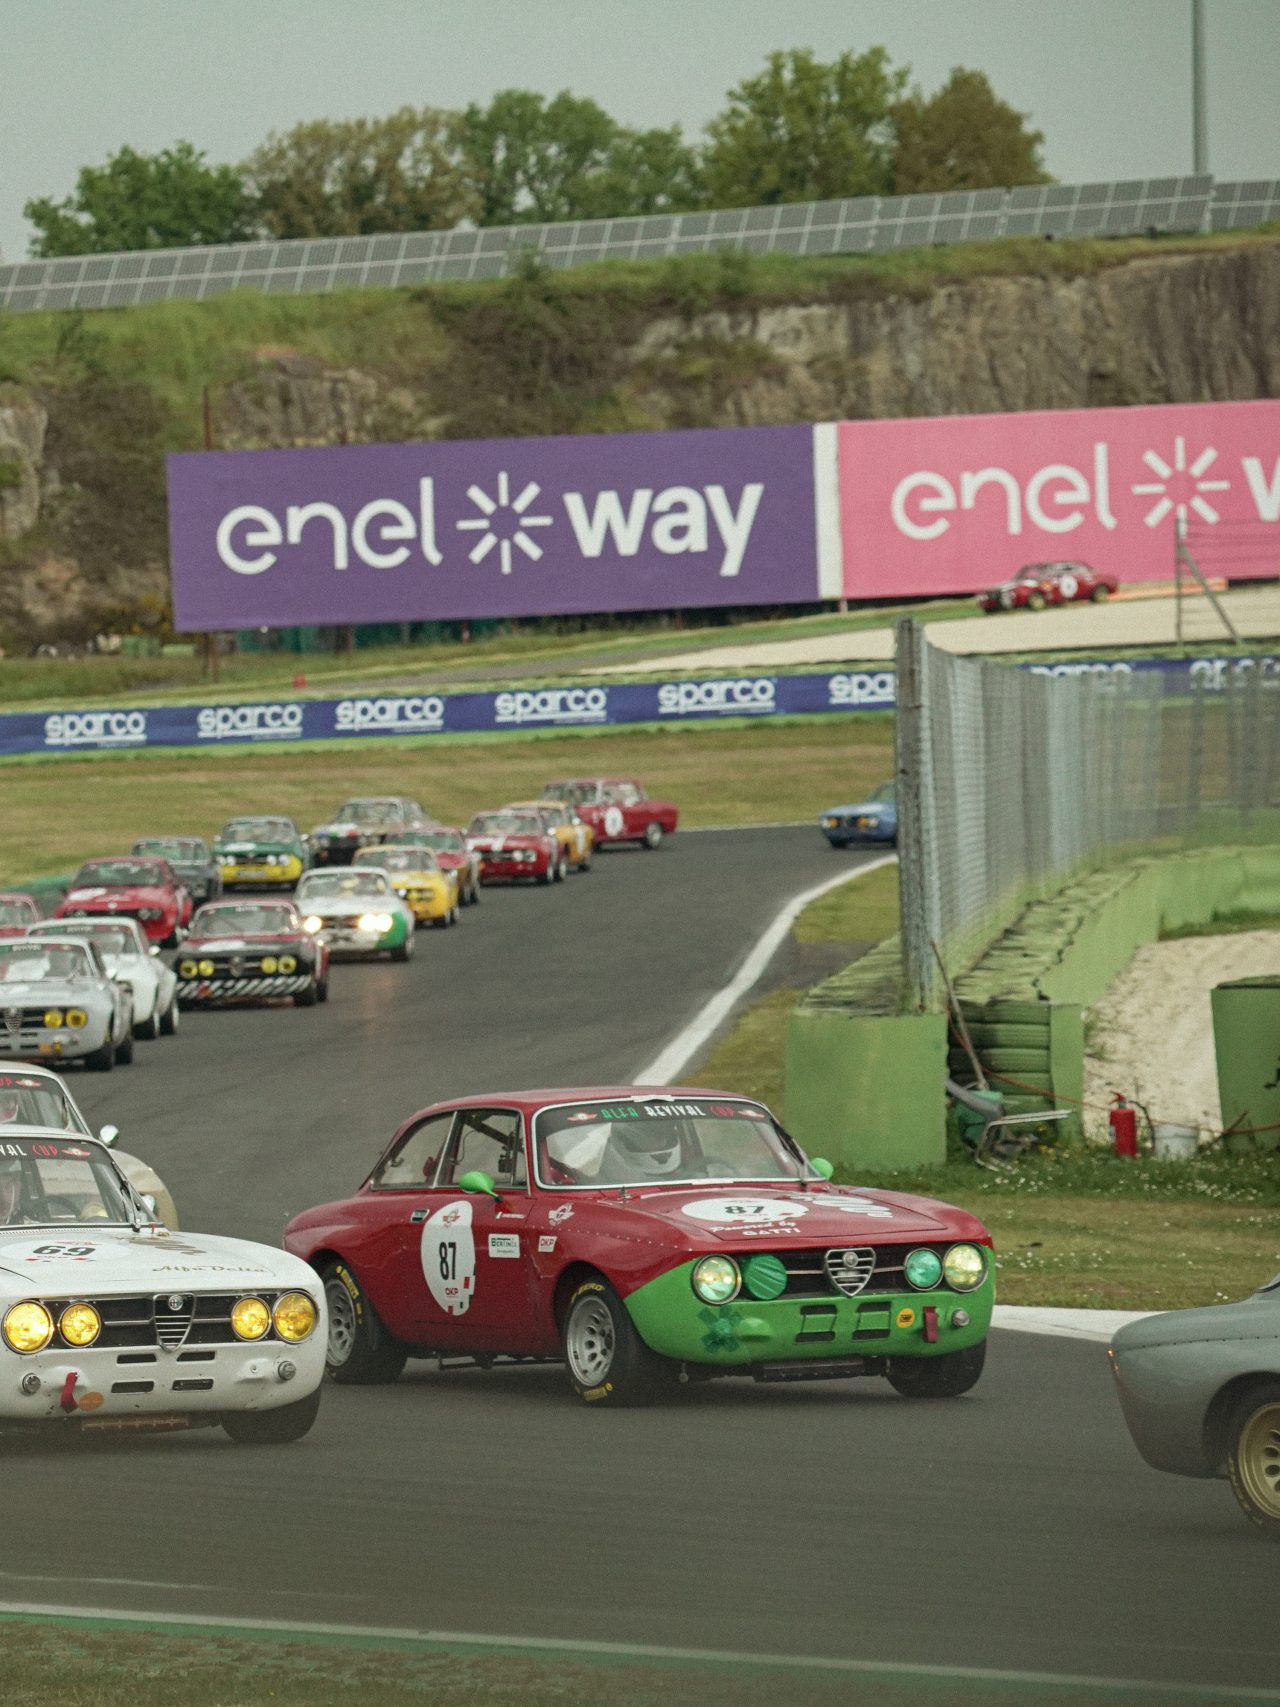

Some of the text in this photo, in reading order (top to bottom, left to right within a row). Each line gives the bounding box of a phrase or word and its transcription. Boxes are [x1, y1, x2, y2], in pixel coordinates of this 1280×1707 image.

[891, 441, 1119, 540] enel
[217, 475, 765, 577] enel way
[657, 678, 776, 713] sparco
[829, 672, 895, 702] spa
[334, 697, 445, 730] sparco
[495, 687, 608, 721] sparco
[45, 712, 145, 742] sparco
[197, 704, 303, 736] sparco
[601, 1106, 639, 1119] ALFA
[644, 1105, 706, 1117] REVIVAL
[31, 1145, 59, 1157] CUP
[725, 1205, 764, 1214] 87
[742, 1228, 801, 1236] GATTI
[33, 1245, 96, 1256] 69
[439, 1242, 456, 1280] 87
